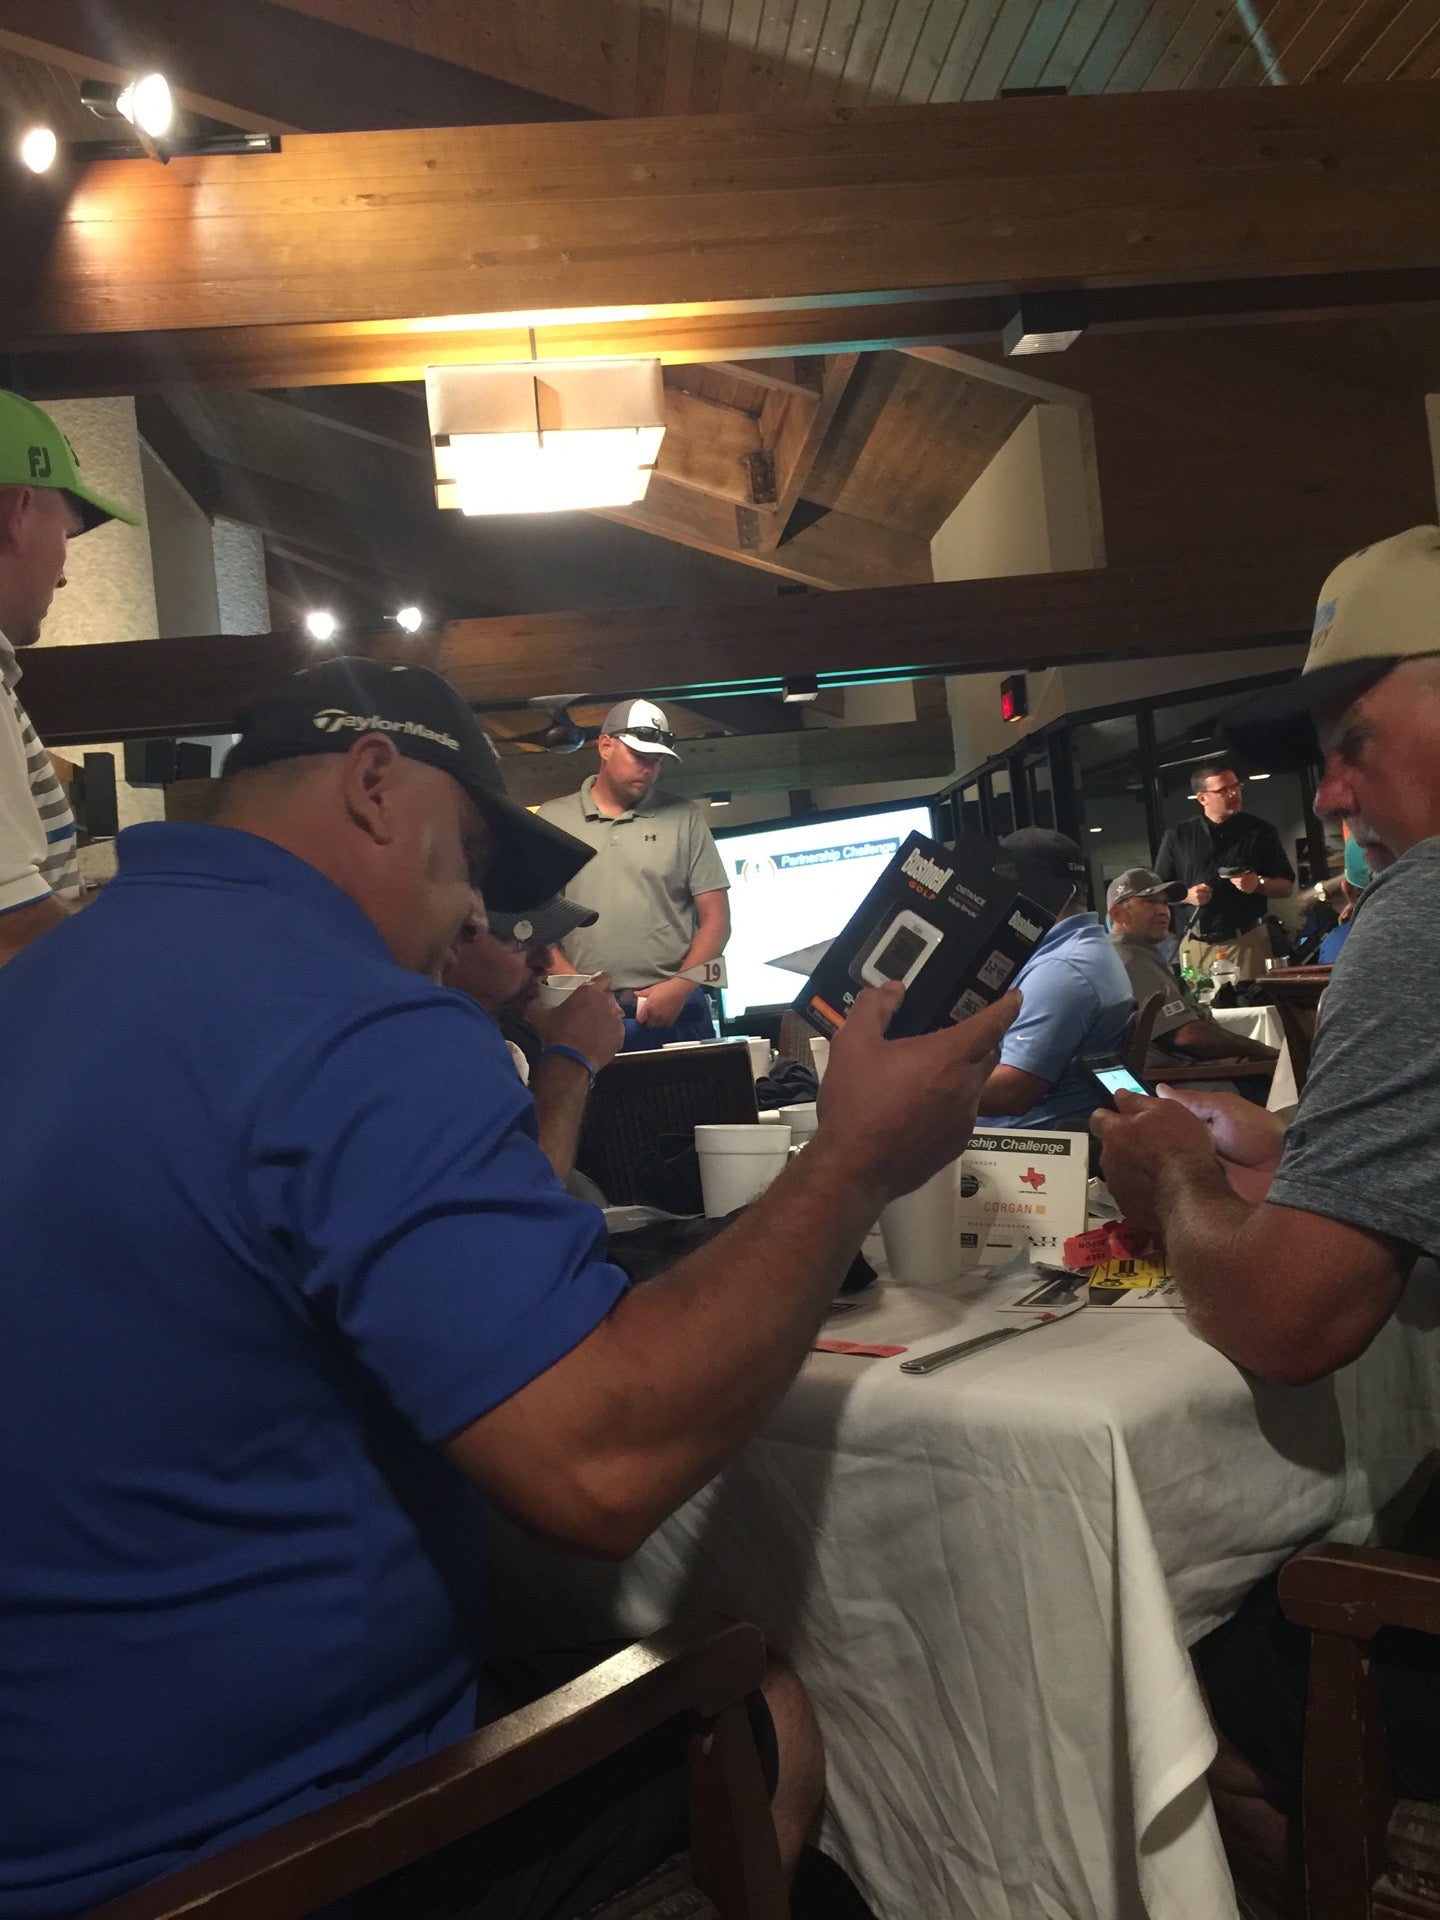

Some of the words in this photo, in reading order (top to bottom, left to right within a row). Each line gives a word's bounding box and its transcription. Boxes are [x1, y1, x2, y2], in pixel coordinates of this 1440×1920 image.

[28, 446, 51, 478] FJ
[313, 708, 461, 751] TaylorMade
[780, 849, 841, 868] Partnership
[842, 841, 897, 860] Challenge
[901, 847, 954, 894] Bushnell
[703, 963, 721, 983] 19
[967, 1138, 998, 1151] rship
[1000, 1138, 1064, 1154] Challenge
[984, 1201, 1033, 1215] CORGAN
